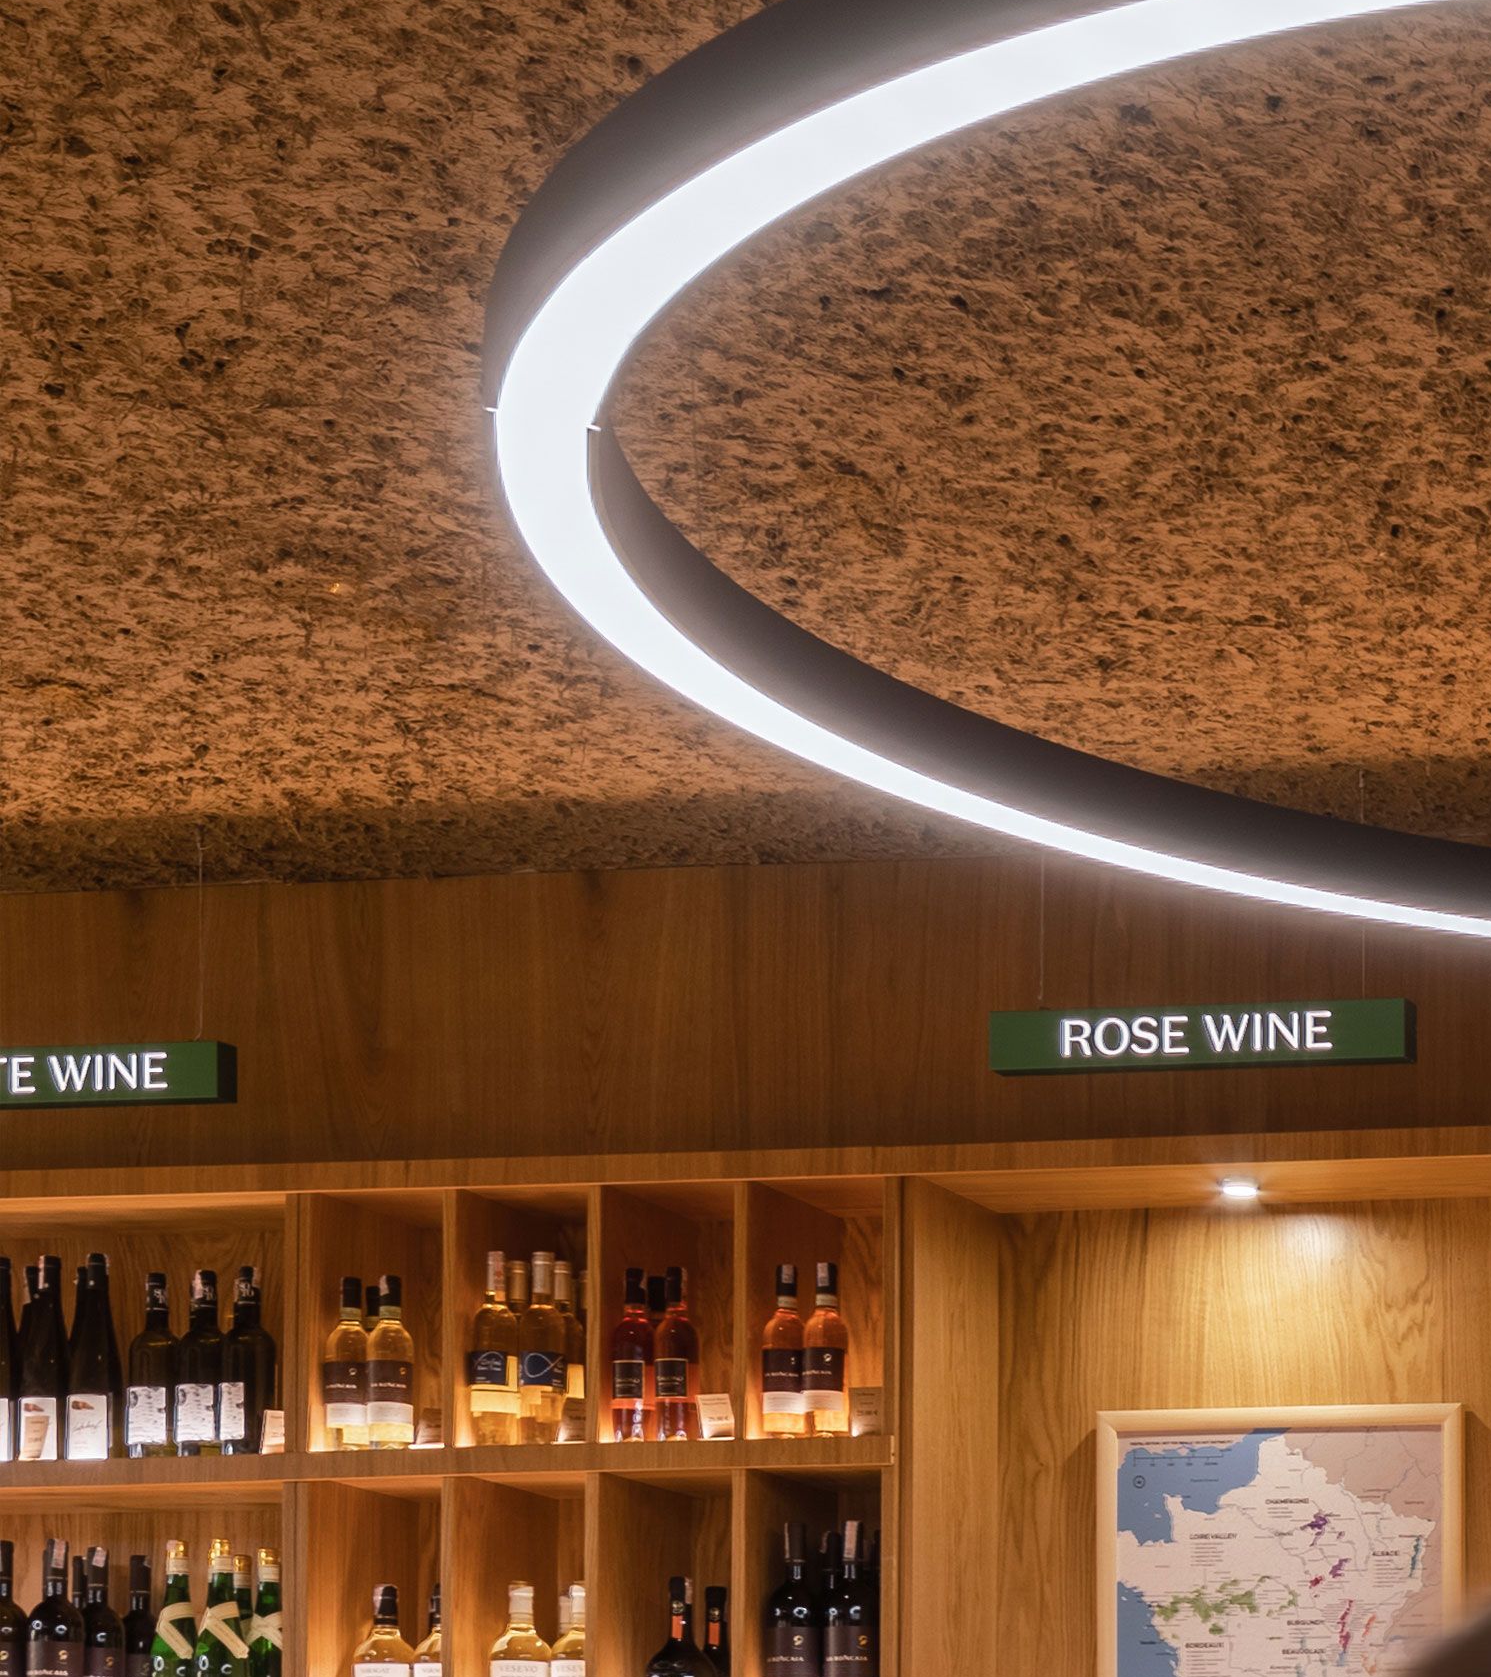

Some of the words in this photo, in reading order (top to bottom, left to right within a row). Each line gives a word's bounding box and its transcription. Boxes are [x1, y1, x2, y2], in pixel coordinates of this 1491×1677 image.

[1059, 1015, 1190, 1059] ROSE
[1200, 1009, 1333, 1055] WINE
[47, 1050, 170, 1093] WINE
